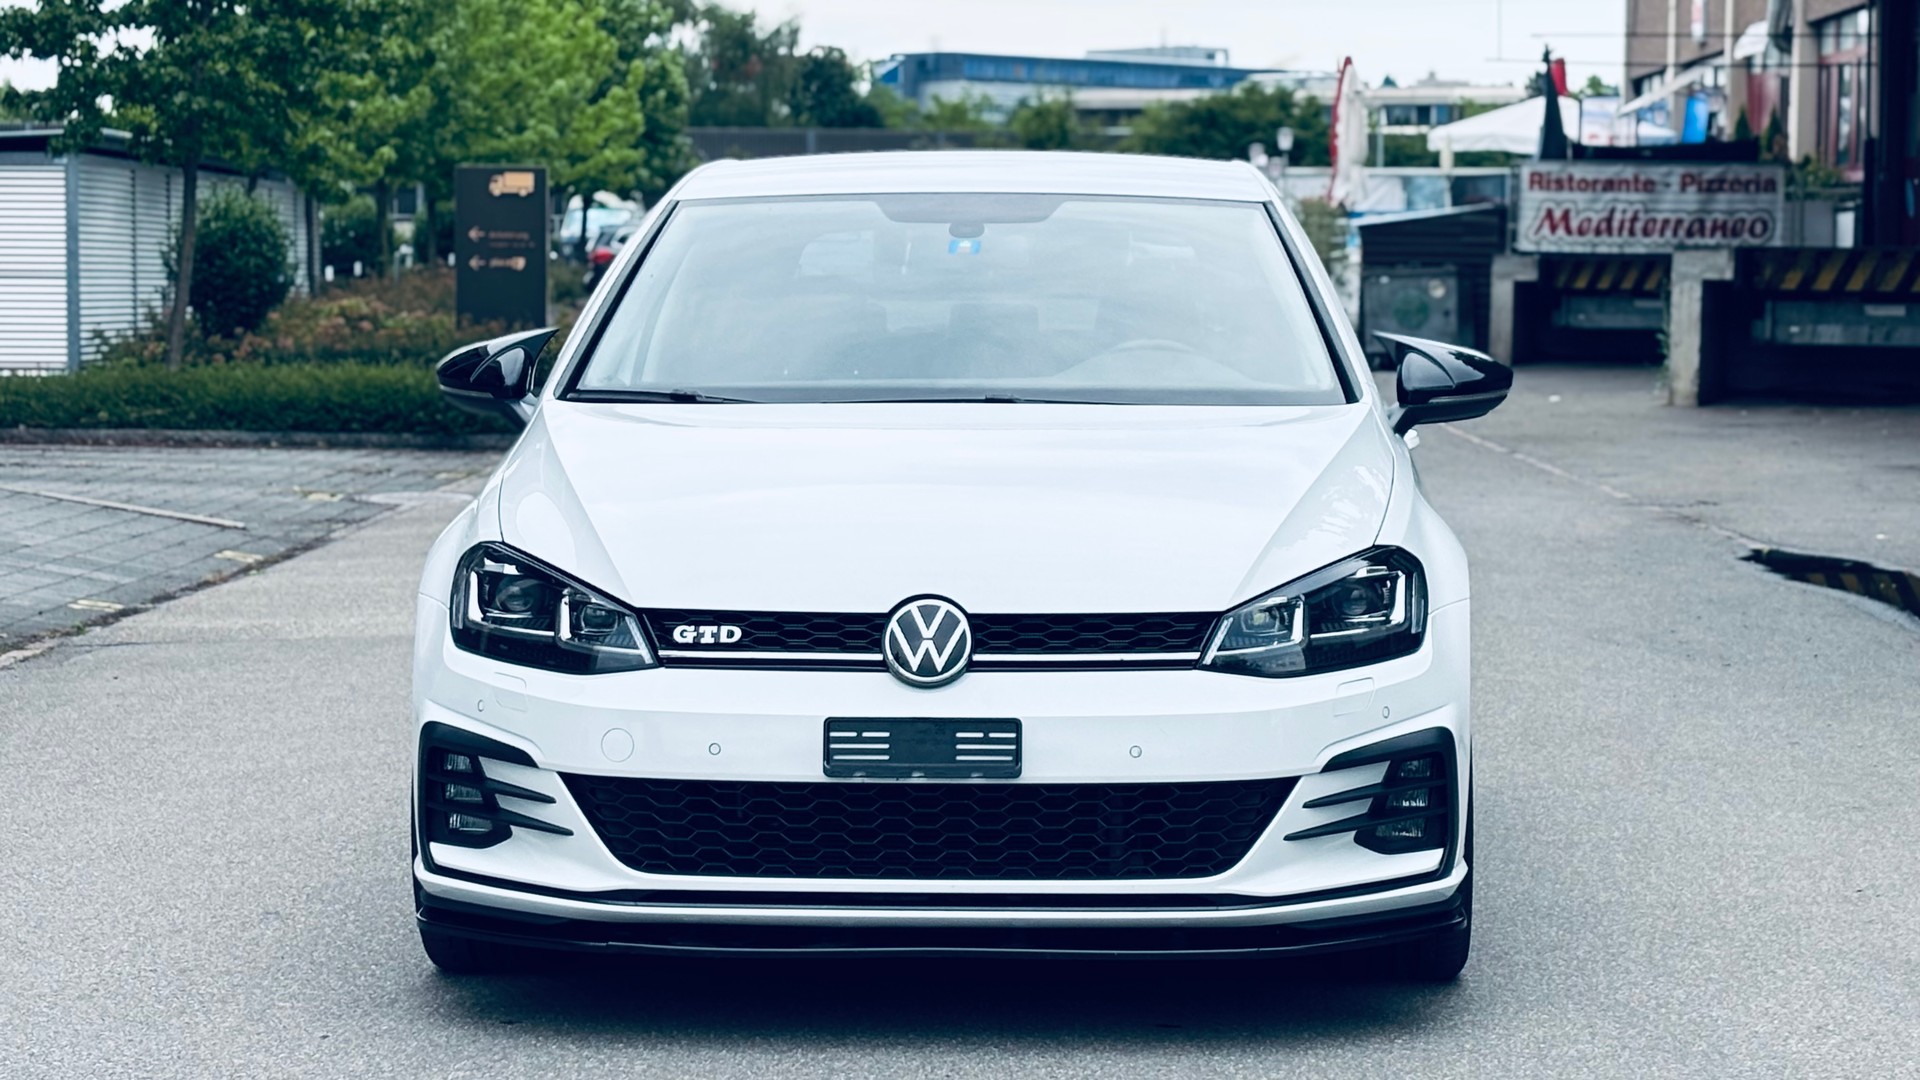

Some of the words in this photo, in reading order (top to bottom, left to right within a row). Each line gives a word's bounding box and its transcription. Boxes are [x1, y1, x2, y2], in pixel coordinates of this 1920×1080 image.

[1529, 171, 1656, 193] Ristorante
[1680, 173, 1777, 193] Pizzeria
[1534, 206, 1769, 239] Mediterraneo
[672, 625, 742, 644] GTD
[886, 602, 971, 673] VW
